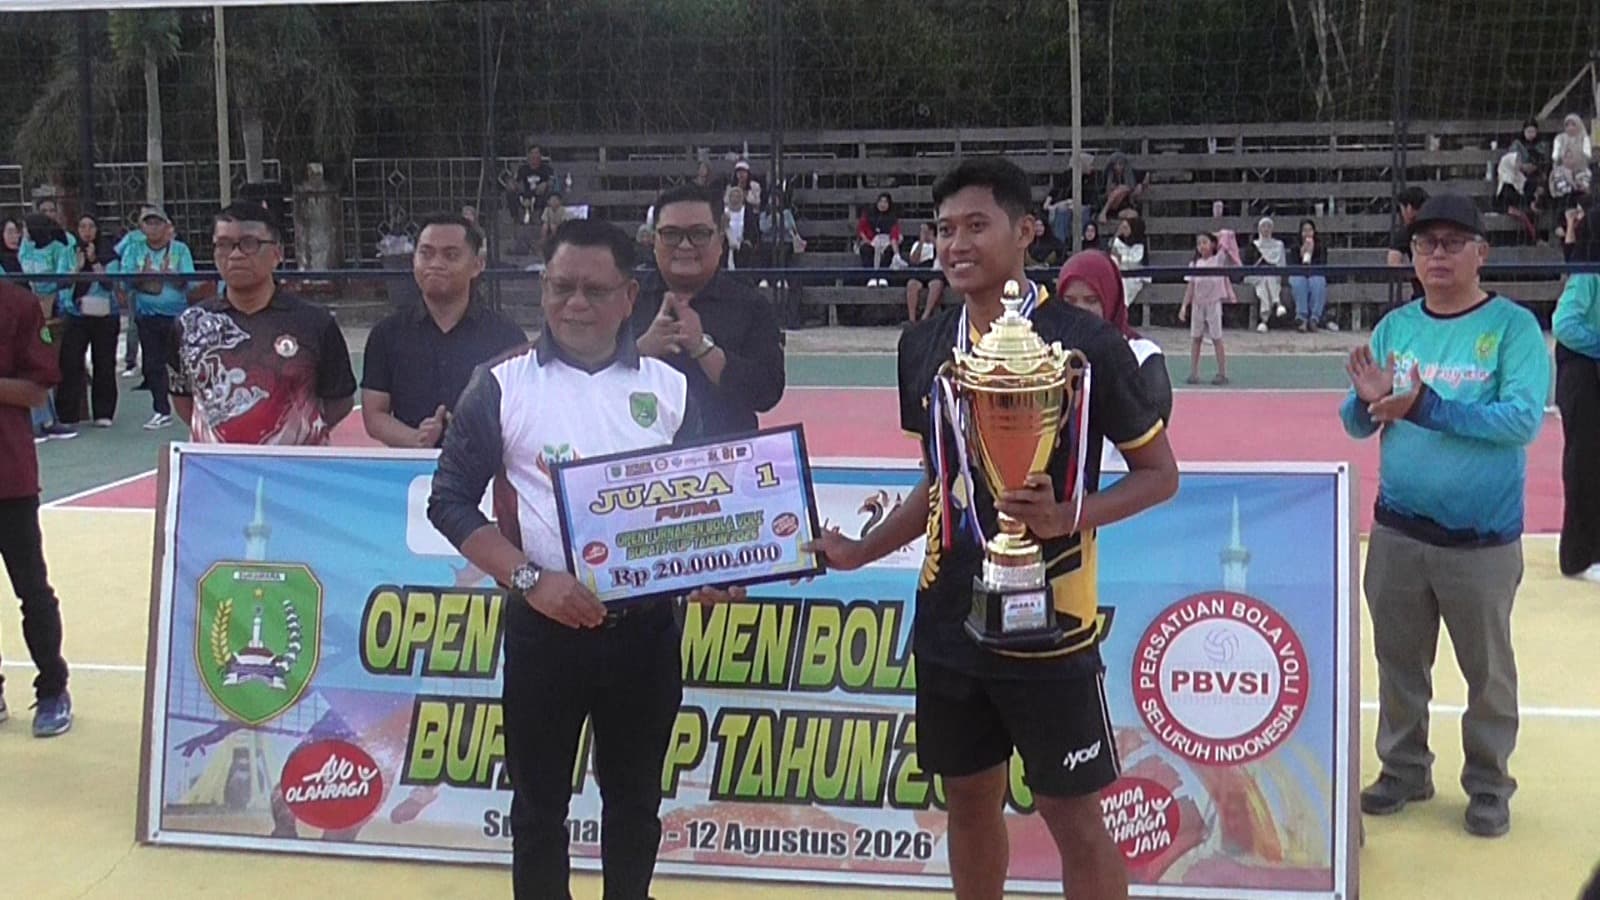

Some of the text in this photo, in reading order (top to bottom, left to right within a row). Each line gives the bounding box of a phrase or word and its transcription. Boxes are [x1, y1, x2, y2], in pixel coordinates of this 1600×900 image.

[590, 462, 780, 515] JUARA 1
[655, 499, 722, 522] PUTRA
[610, 544, 780, 588] Rp 20.000.000
[362, 588, 504, 676] OPEN
[1139, 599, 1225, 689] PERSATUAN
[1231, 601, 1283, 644] BOLA
[1279, 642, 1300, 695] VOLI
[1171, 670, 1270, 695] PBVSI
[1142, 697, 1298, 762] SELURUH INDONESIA
[302, 753, 354, 782] AYO
[714, 711, 892, 802] TAHUN
[285, 780, 369, 803] OLAHRAGA
[686, 821, 718, 850] 12
[725, 822, 847, 857] Agustus
[854, 828, 933, 860] 2026
[1110, 811, 1167, 844] HRAGA
[1126, 830, 1171, 858] JAYA
